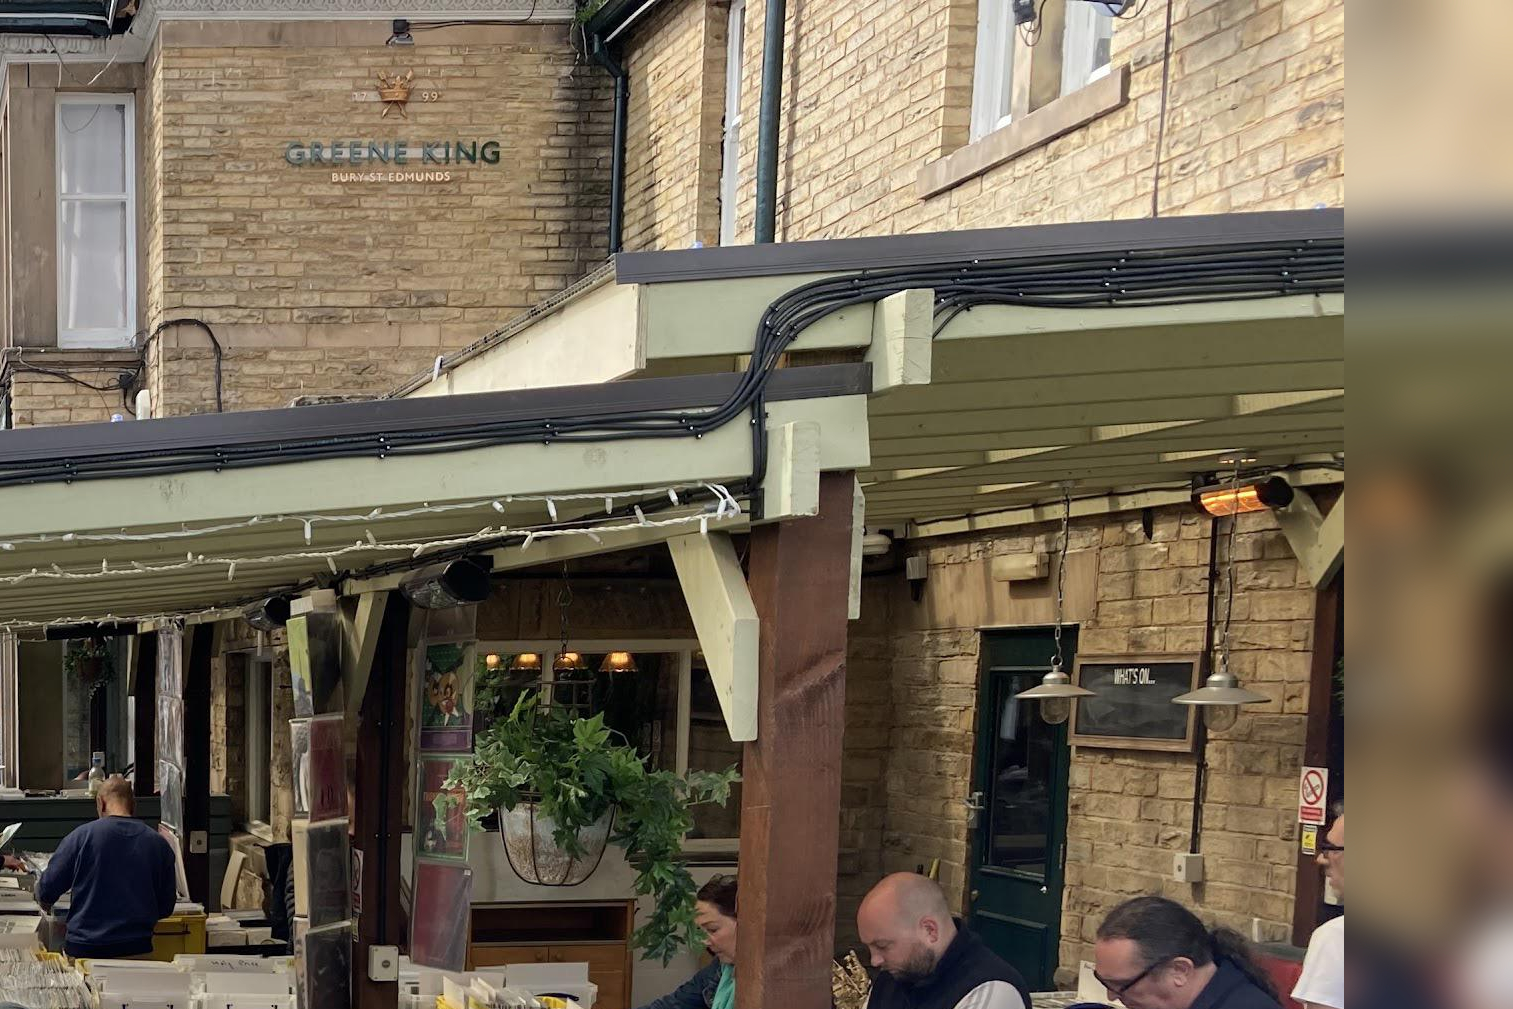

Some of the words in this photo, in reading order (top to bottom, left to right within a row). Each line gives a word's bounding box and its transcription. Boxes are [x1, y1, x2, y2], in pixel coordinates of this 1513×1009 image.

[422, 92, 439, 102] 99
[286, 141, 407, 165] GREENE
[422, 141, 501, 164] KING
[332, 172, 365, 182] BURY
[369, 172, 383, 182] ST
[388, 171, 451, 182] EDMUNDS
[1114, 668, 1138, 685] WHAT'S
